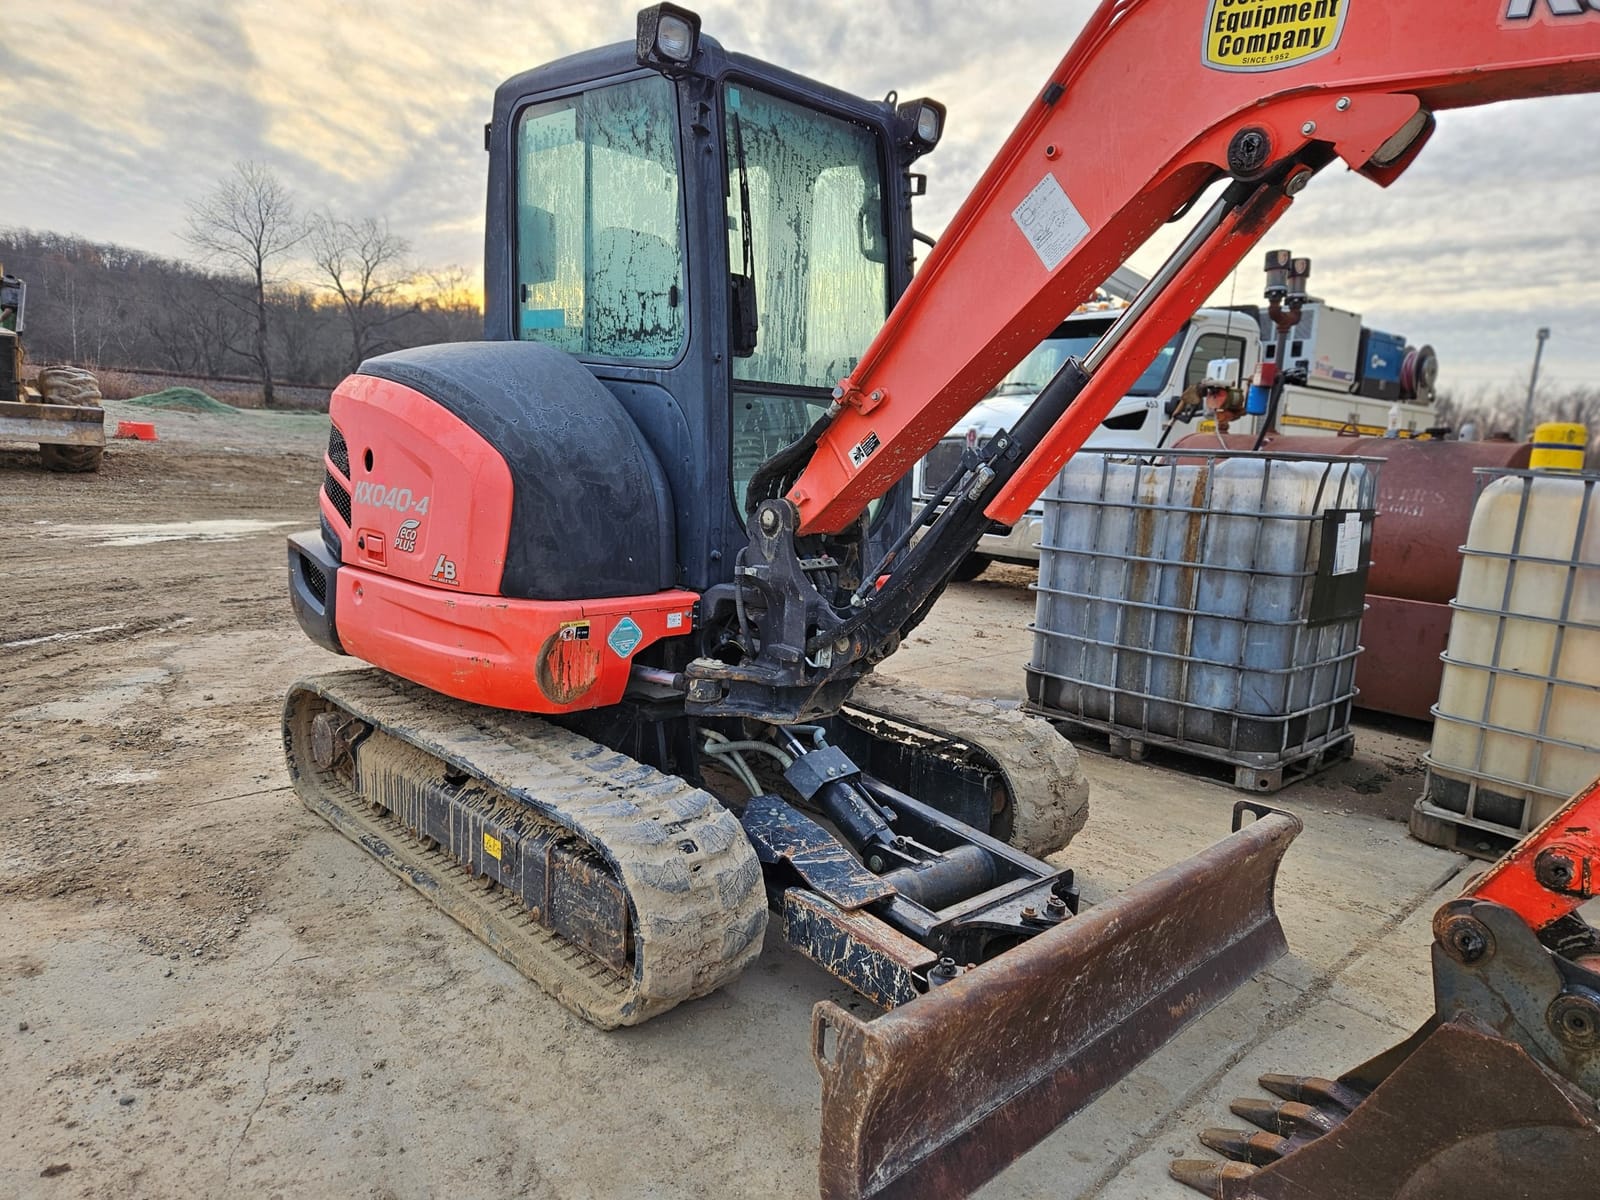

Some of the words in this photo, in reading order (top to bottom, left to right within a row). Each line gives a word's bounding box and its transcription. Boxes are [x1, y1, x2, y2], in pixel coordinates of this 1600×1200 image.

[1215, 0, 1338, 33] Equipment
[1217, 26, 1326, 57] Company
[1242, 56, 1266, 64] SINCE
[1270, 52, 1290, 62] 1952
[354, 481, 430, 516] KX040-4
[394, 538, 416, 553] PLUS
